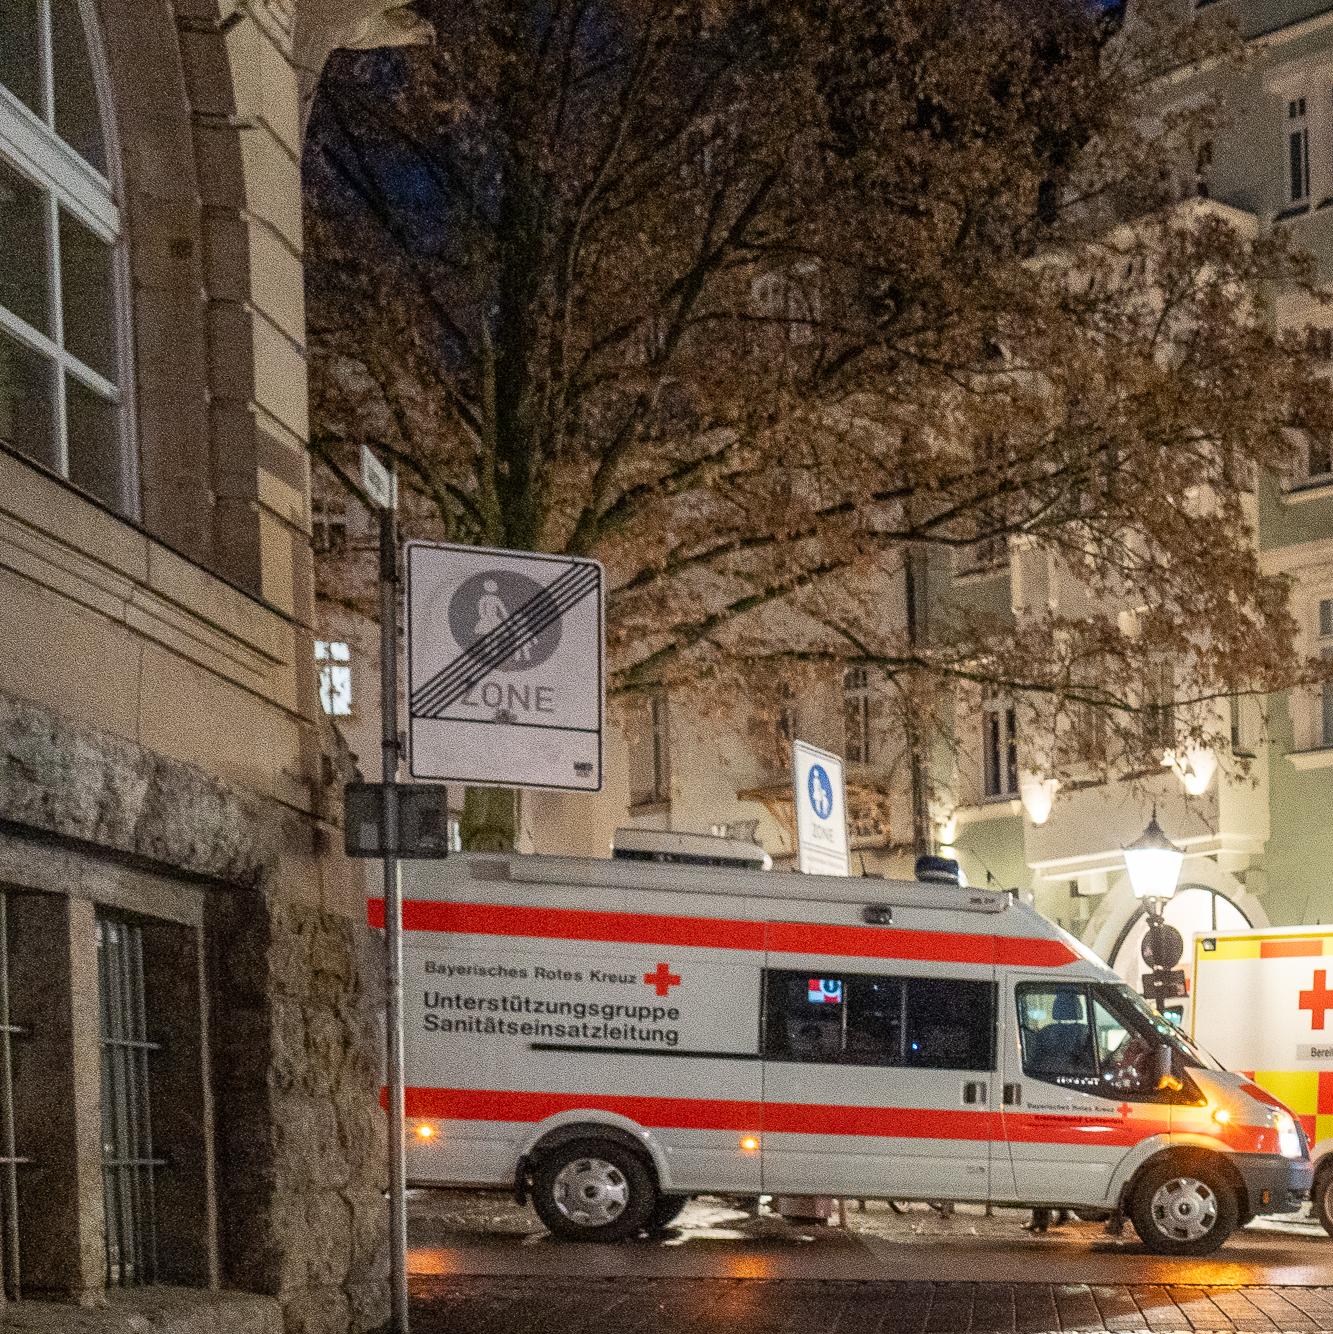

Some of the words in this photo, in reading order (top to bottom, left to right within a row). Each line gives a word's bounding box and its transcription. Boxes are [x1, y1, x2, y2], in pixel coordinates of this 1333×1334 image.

[461, 679, 554, 713] ZONE
[424, 961, 528, 980] Bayerisches
[534, 967, 584, 982] Rotes
[590, 970, 637, 985] Kreuz
[422, 991, 680, 1022] Unterstützungsgruppe
[422, 1013, 680, 1046] Sanitätseinsatzleitung
